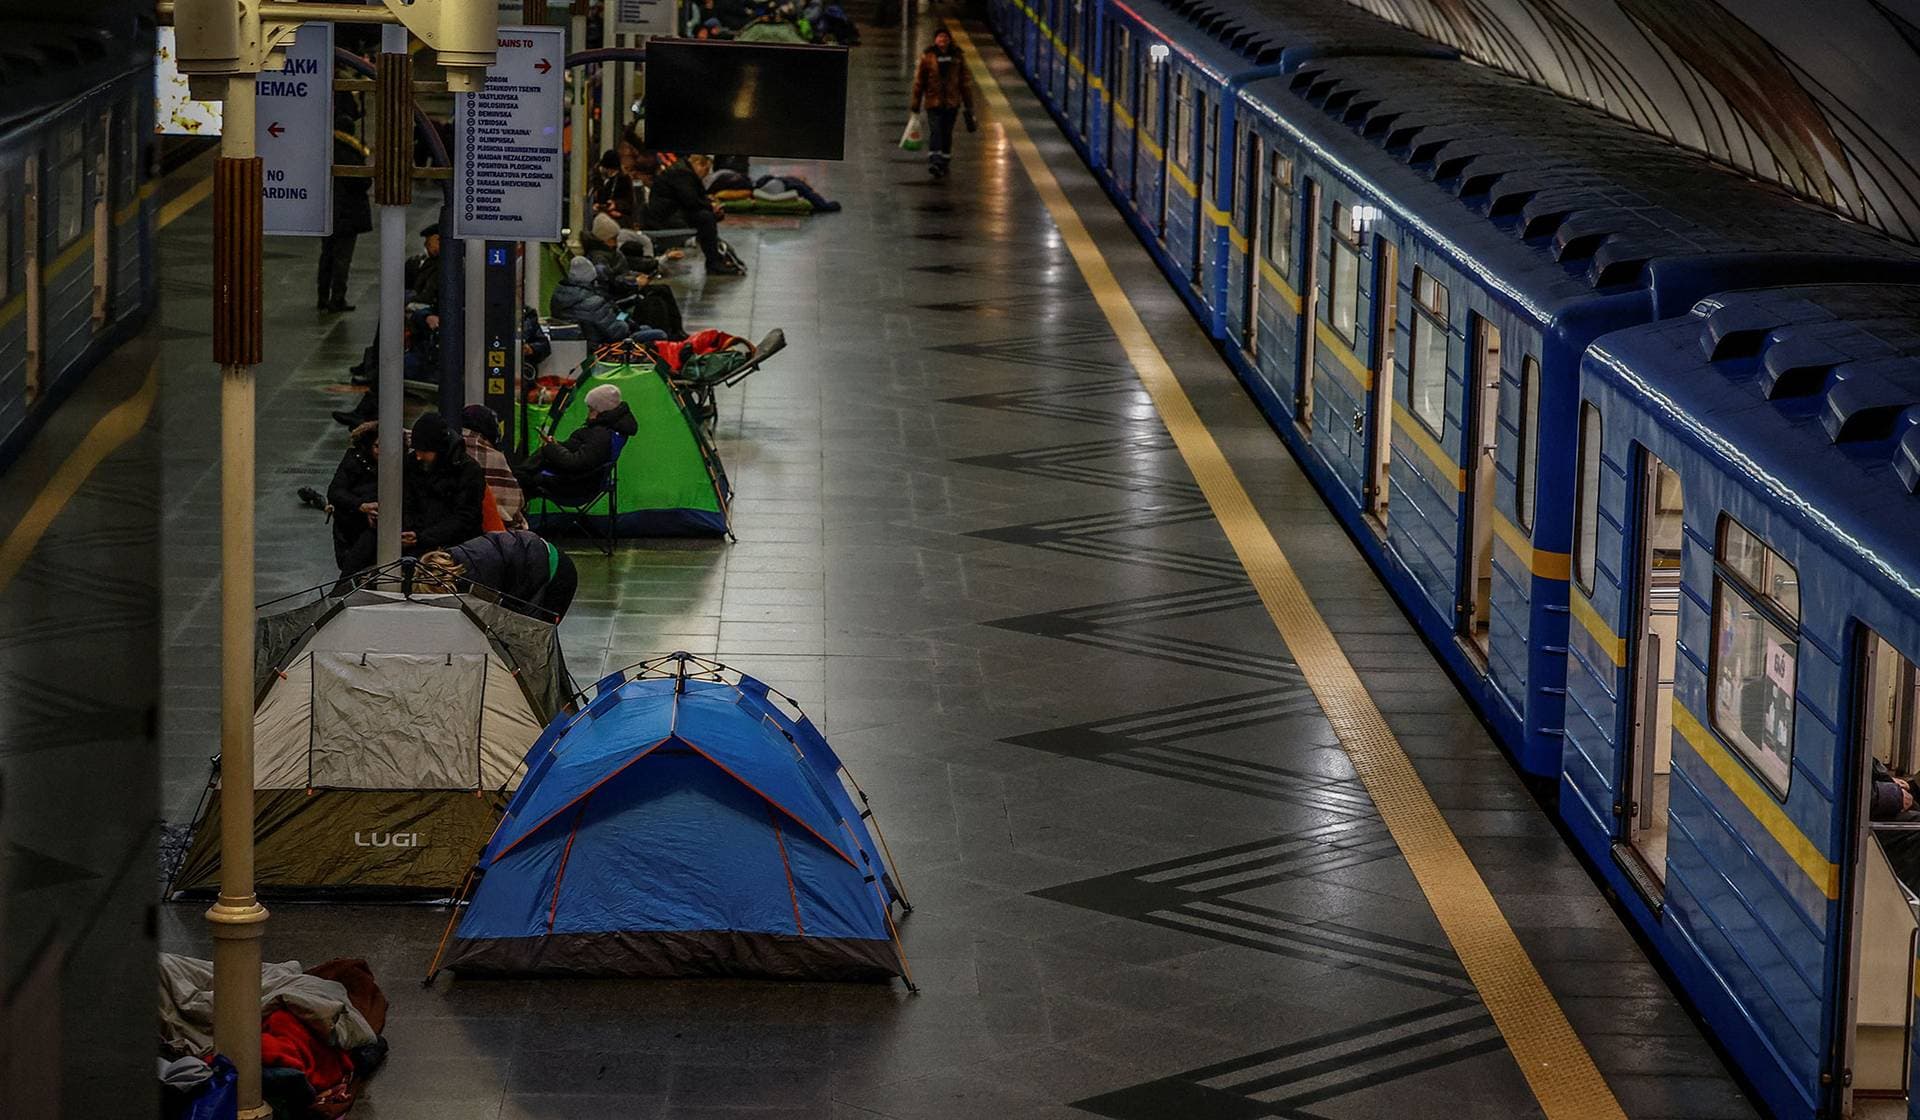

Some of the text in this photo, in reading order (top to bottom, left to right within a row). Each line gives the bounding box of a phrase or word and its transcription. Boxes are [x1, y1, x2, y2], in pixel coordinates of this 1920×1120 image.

[523, 40, 534, 48] TO
[267, 170, 284, 181] NO
[354, 831, 417, 847] LUGI
